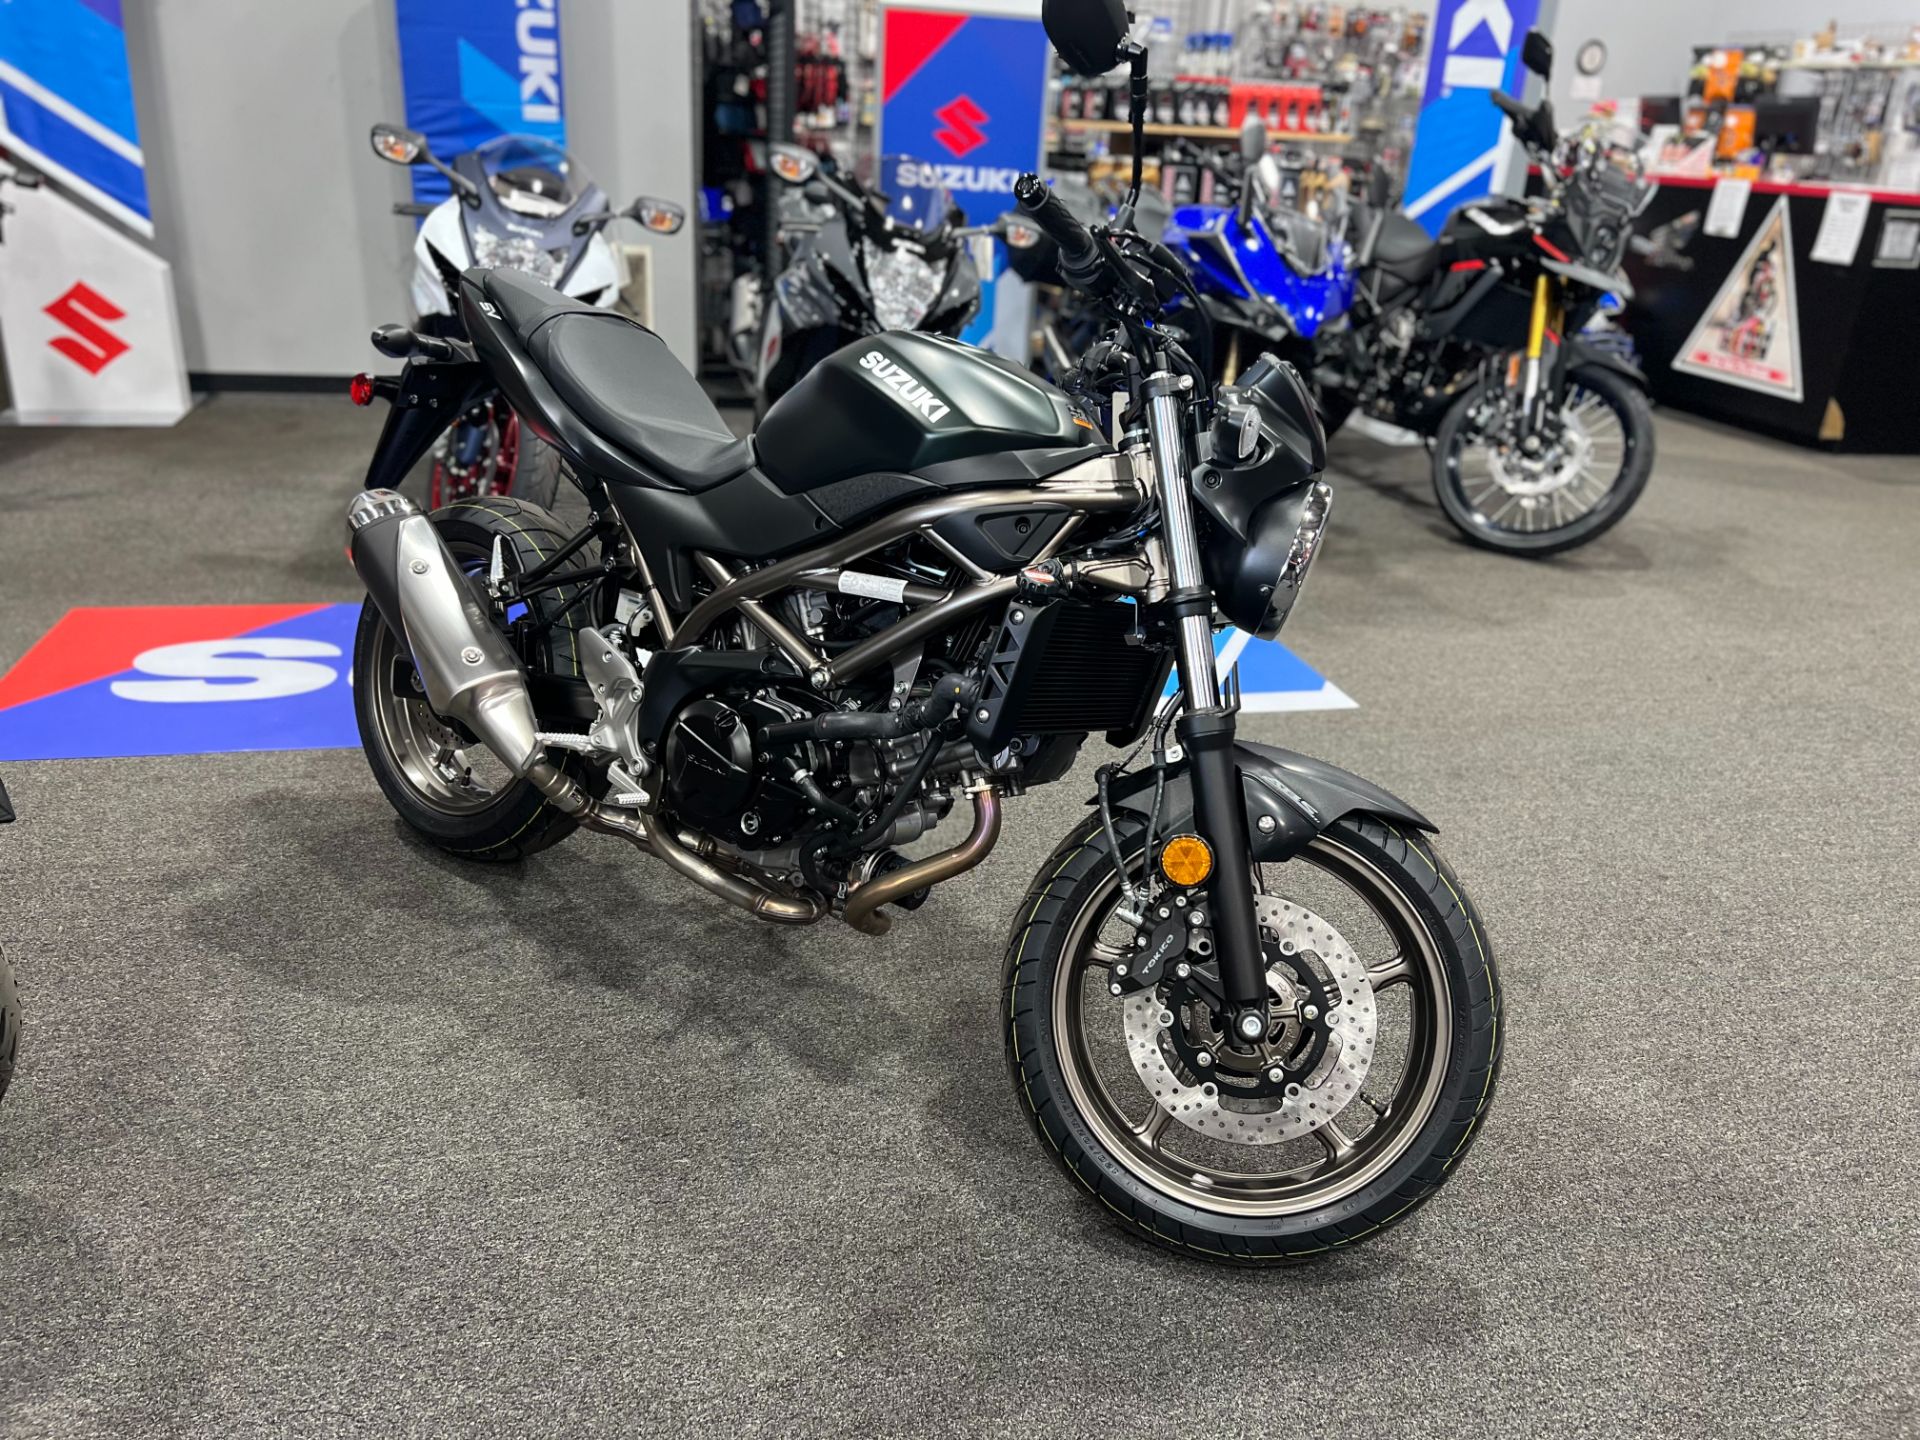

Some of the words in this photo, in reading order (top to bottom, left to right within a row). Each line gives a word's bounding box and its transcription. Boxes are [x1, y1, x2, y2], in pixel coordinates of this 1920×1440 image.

[516, 0, 560, 122] UKI
[479, 301, 502, 320] SV
[859, 350, 951, 424] SUZUKI
[110, 637, 354, 703] S
[1142, 934, 1174, 974] TOKICO
